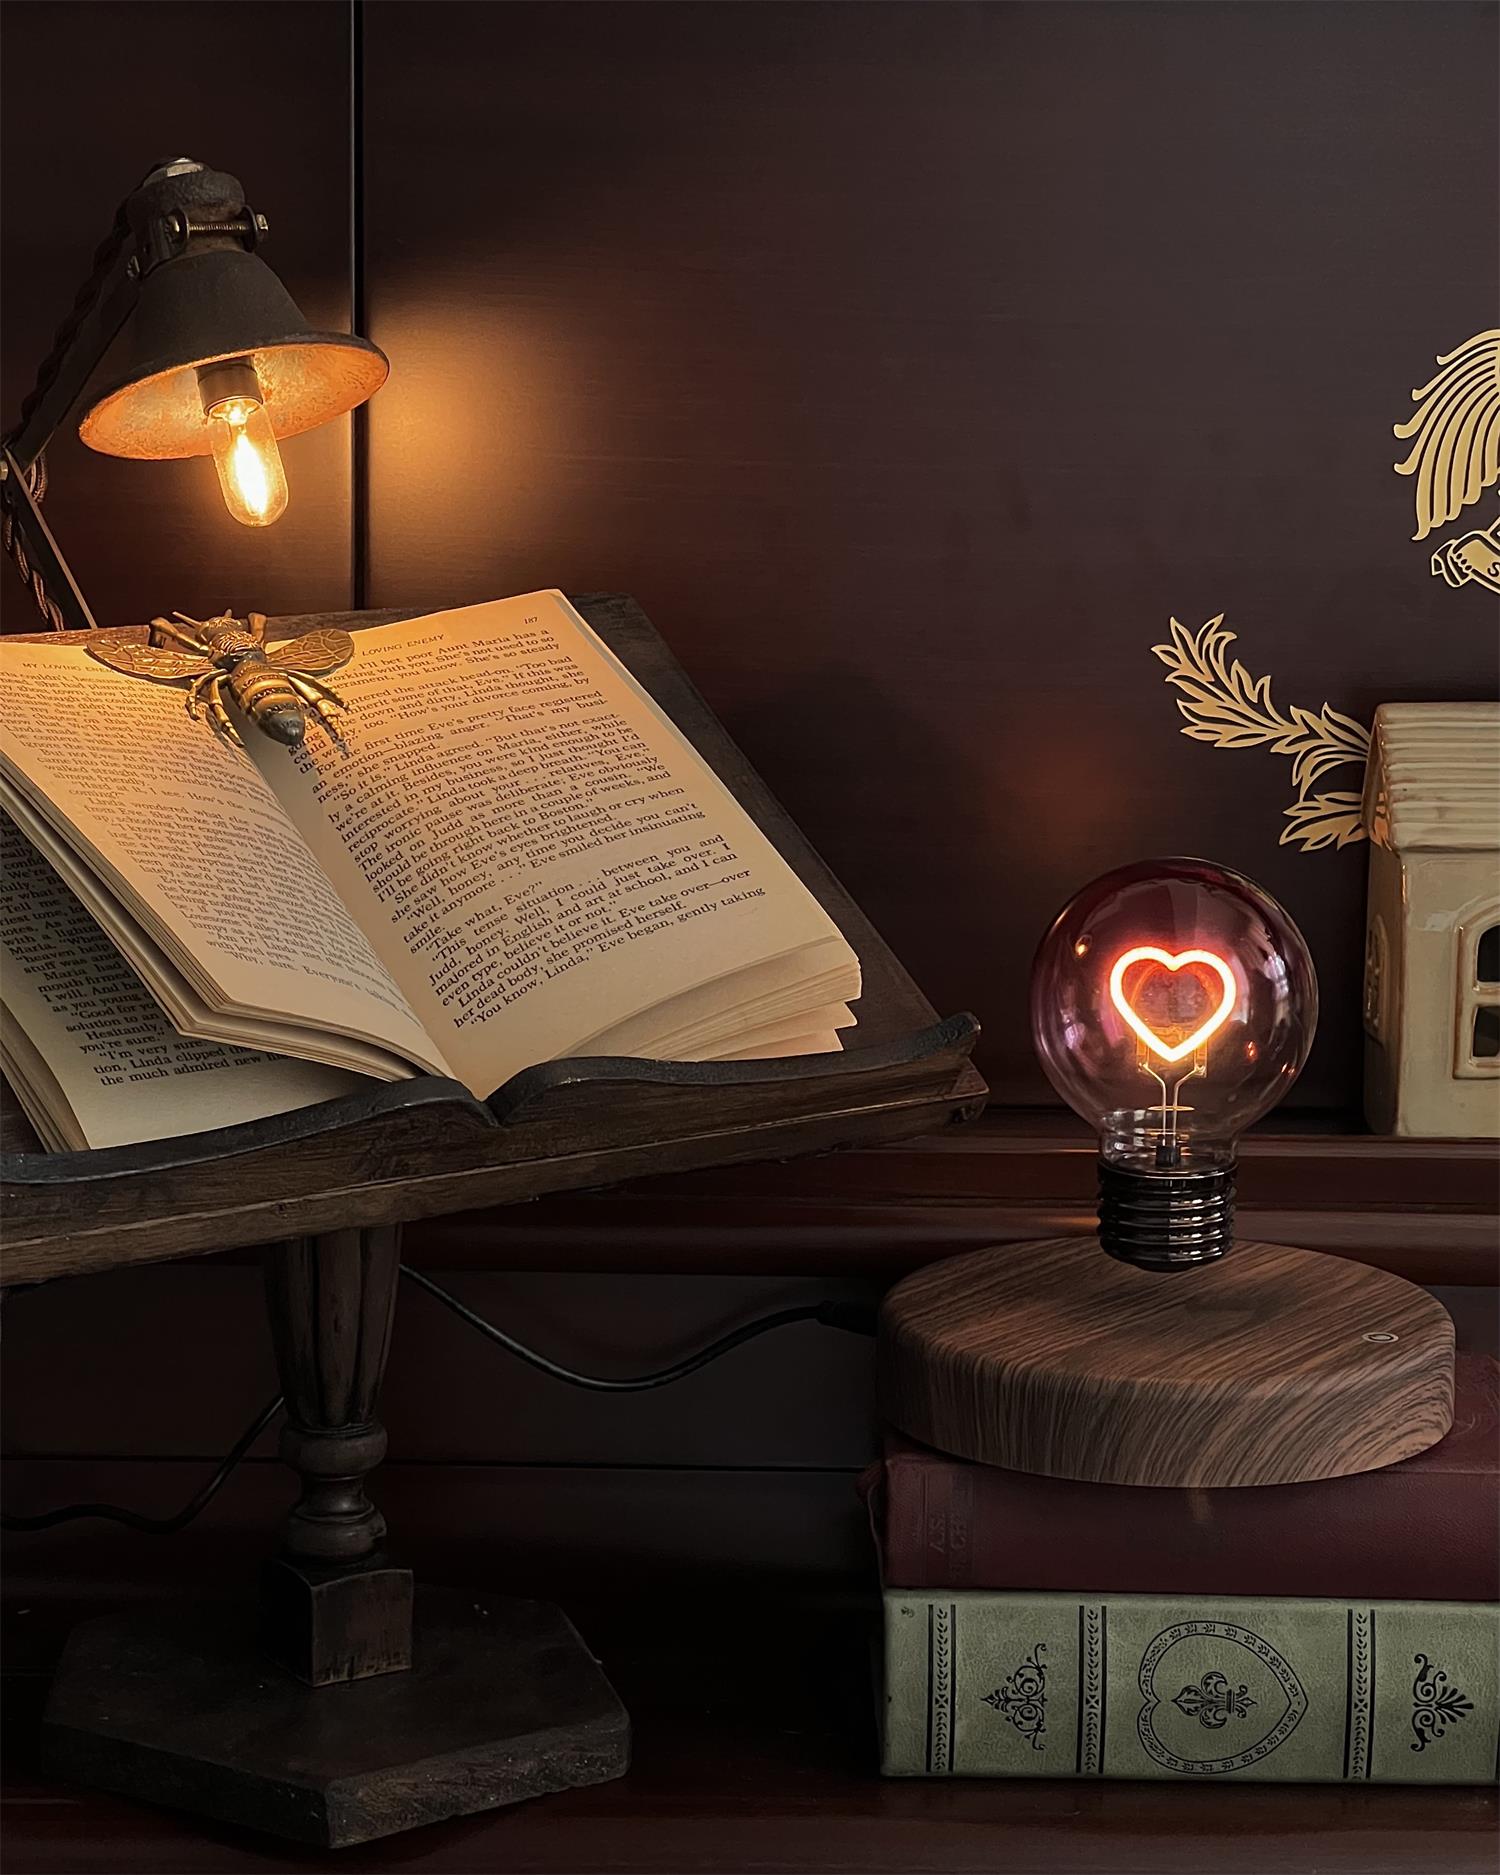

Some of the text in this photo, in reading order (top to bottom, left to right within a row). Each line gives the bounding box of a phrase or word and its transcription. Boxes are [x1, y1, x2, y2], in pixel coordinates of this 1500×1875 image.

[362, 634, 444, 656] LOVING ENEMY
[380, 657, 402, 665] bet
[405, 651, 433, 662] poor
[438, 643, 469, 654] Aunt
[471, 637, 510, 647] Maria
[511, 632, 536, 640] has
[524, 616, 538, 624] 187
[317, 741, 440, 804] ness,” she snapped.
[330, 713, 619, 801] “So it is,” Linda agreed. “But that's not exact-
[377, 802, 588, 902] I'll be going right back to Boston.”
[391, 813, 617, 923] she saw how Eve's eyes brightened.
[394, 787, 685, 904] She didn't know whether to laugh or cry when
[404, 802, 697, 920] “Well, honey, any time you decide you can't
[410, 926, 445, 953] smile.
[423, 880, 542, 951] “Take what, Eve?”
[434, 853, 738, 995] majored in English and art at school, and I can
[436, 839, 730, 987] Judd, honey. Well, I could just take over. I
[457, 871, 750, 1008] Linda couldn't believe it. Eve take over—over
[442, 900, 616, 1006] even type, believe it or not.”
[453, 900, 687, 1028] her dead body, she promised herself.
[470, 887, 765, 1024] “You know, Linda,” Eve began, gently taking
[65, 1011, 159, 1032] solution to an
[79, 1030, 168, 1054] you're sure.”
[85, 1022, 163, 1040] Hesitantly,
[98, 1038, 207, 1060] “I'm very sure.
[92, 1045, 228, 1073] tion, Linda clipped
[100, 1054, 261, 1086] the much admired new
